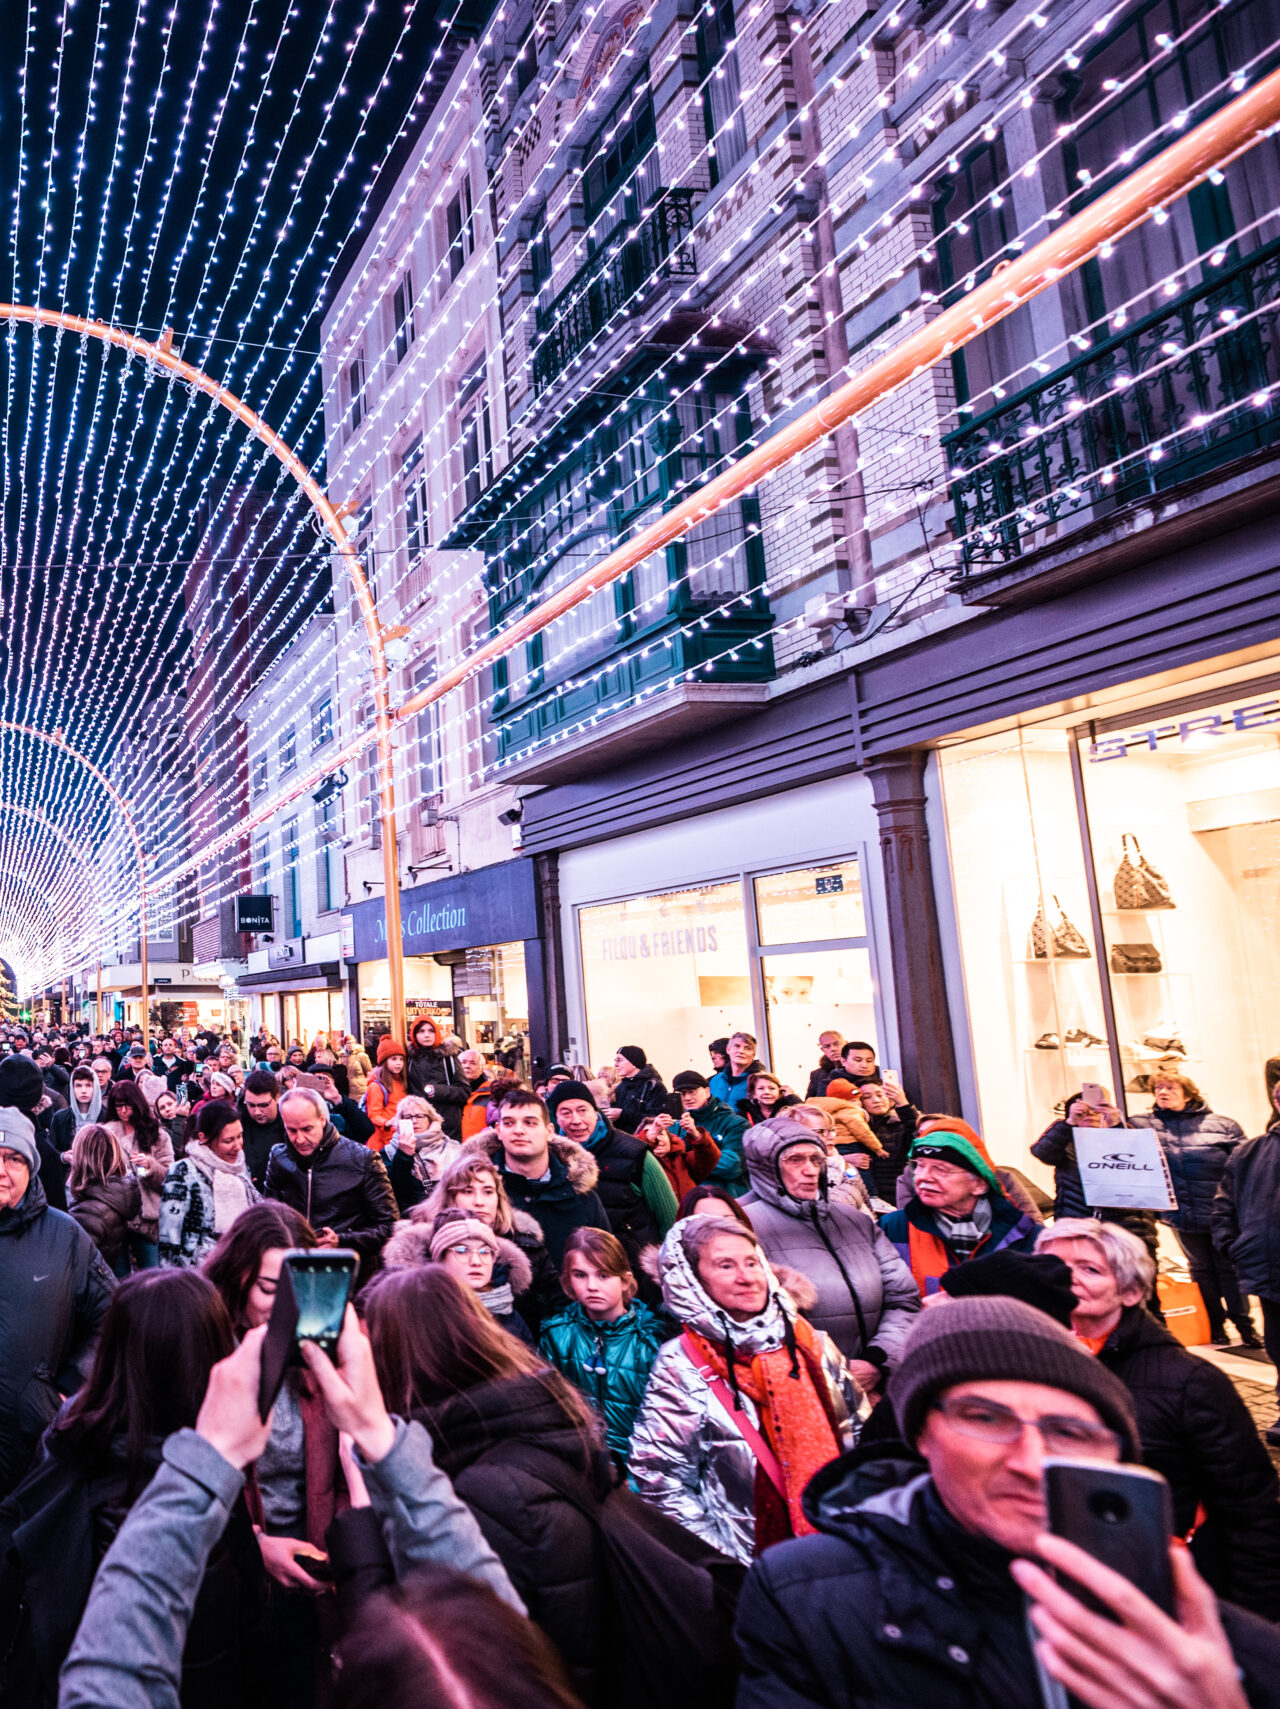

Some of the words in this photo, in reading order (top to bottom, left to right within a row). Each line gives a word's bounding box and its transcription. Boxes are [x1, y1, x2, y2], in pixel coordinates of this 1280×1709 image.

[374, 919, 406, 943] Ms
[407, 903, 466, 937] Collection
[640, 933, 651, 958] &
[652, 925, 718, 957] FRIENDS
[415, 1001, 438, 1009] TOTALE
